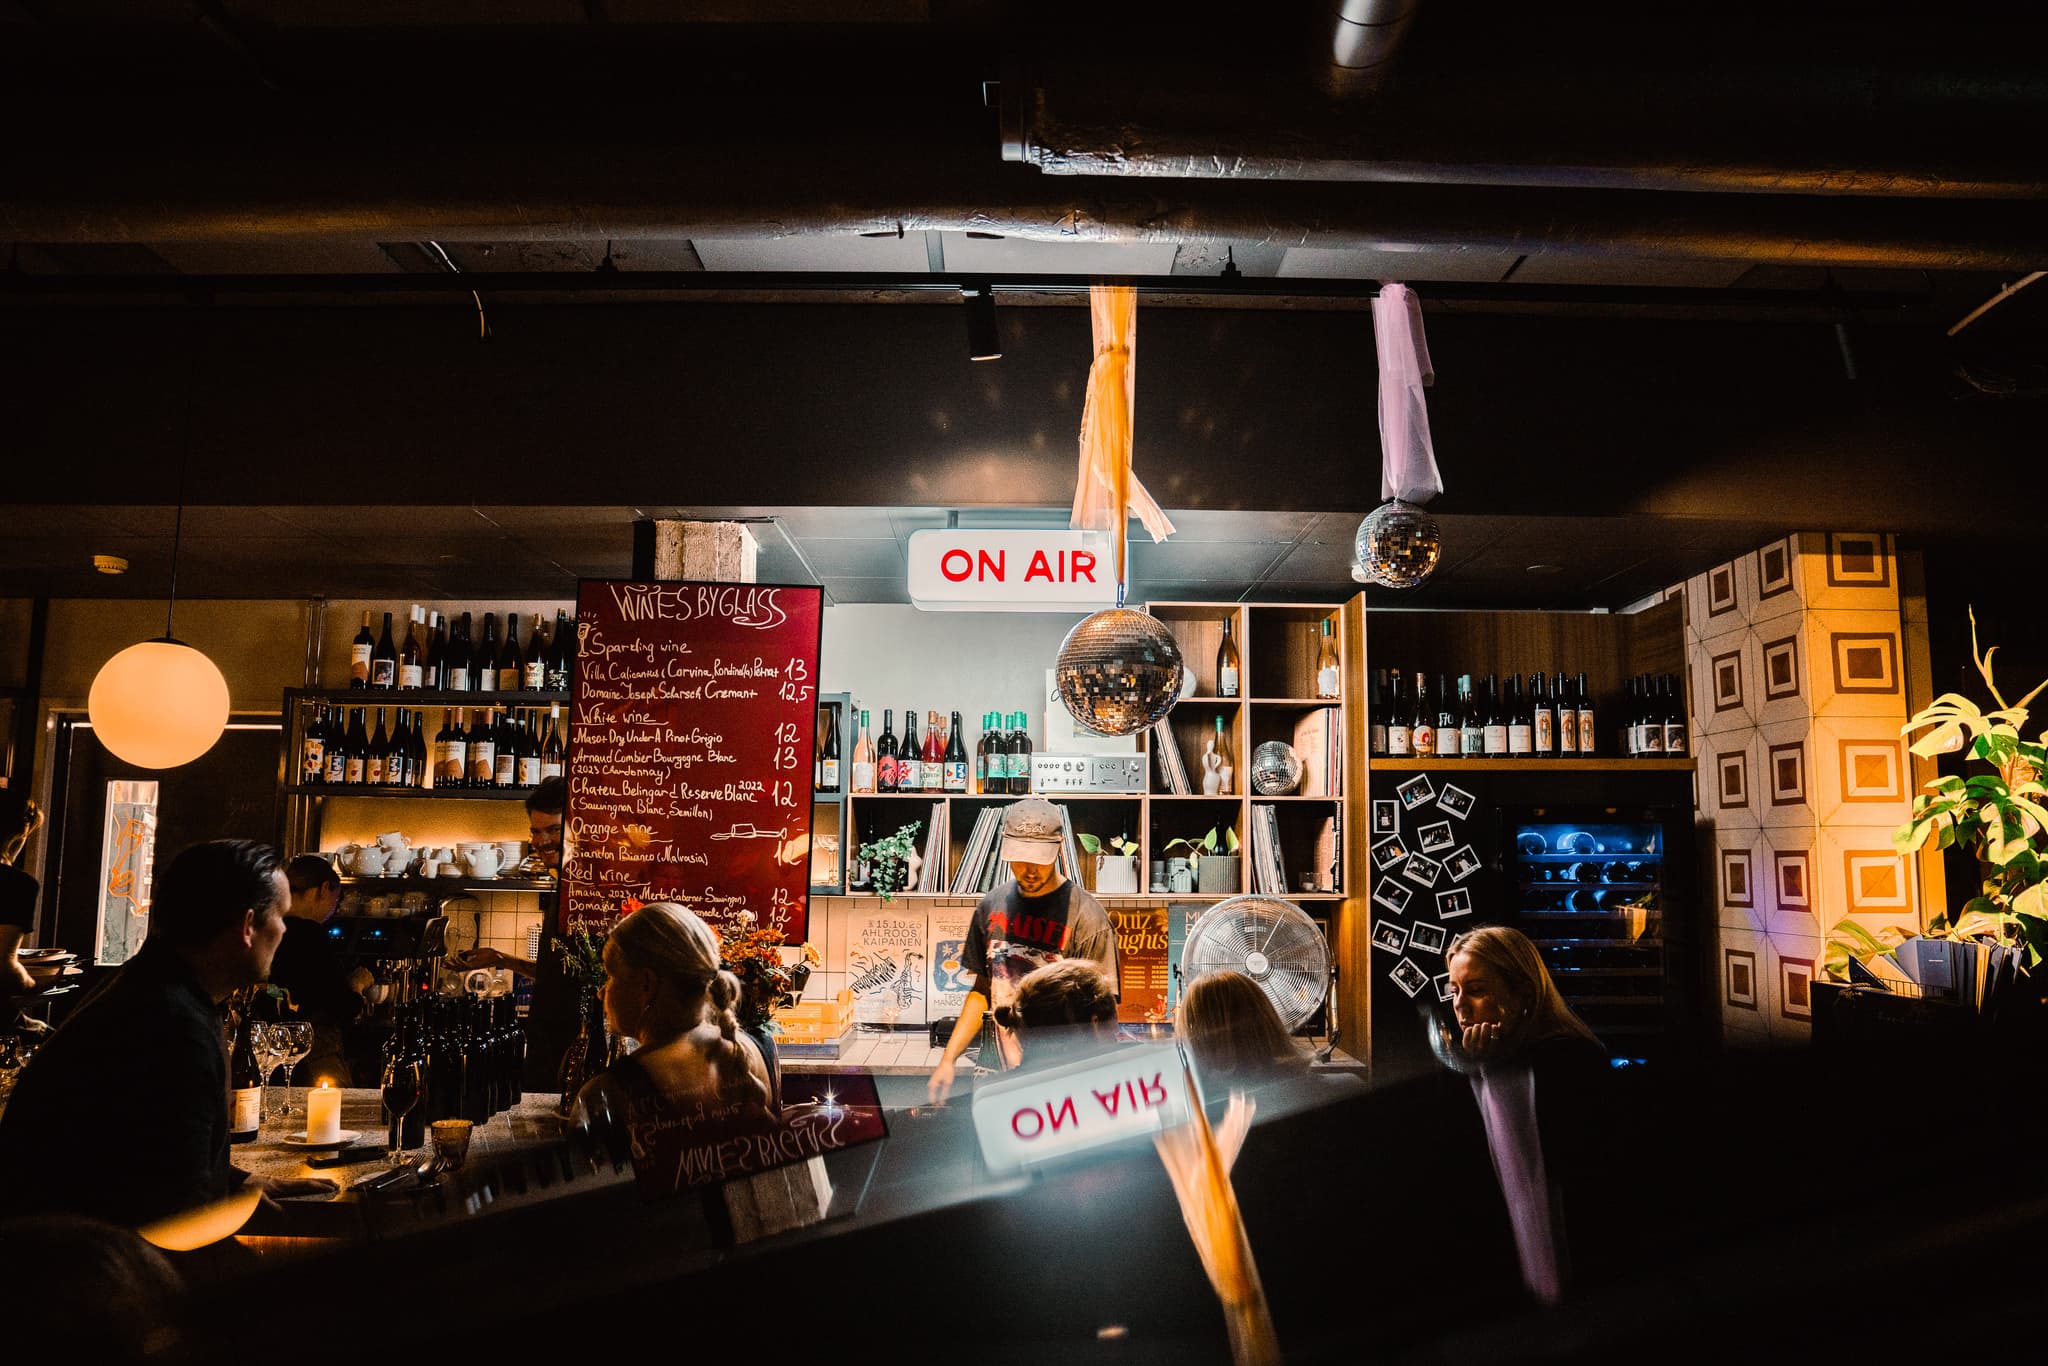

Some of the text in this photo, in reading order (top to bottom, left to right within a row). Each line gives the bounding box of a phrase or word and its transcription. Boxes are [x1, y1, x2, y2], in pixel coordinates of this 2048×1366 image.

[940, 549, 1097, 583] ON AIR
[610, 584, 692, 621] WINES
[660, 640, 693, 654] wine
[581, 660, 607, 681] Villa
[784, 657, 808, 681] 13
[581, 681, 620, 700] Domaine
[619, 681, 659, 704] Joseph
[778, 681, 815, 704] 12,5
[578, 702, 657, 724] White wine
[609, 728, 626, 747] Dry
[665, 728, 691, 743] Pinot
[691, 727, 723, 749] Grigio
[774, 723, 801, 745] 12
[573, 747, 613, 764] Arnaud
[653, 747, 704, 769] Bourgogne
[707, 749, 737, 763] Blanc
[773, 746, 798, 770] 13
[681, 782, 724, 800] Reserve
[723, 783, 758, 803] Blanc
[738, 780, 766, 793] 2022
[771, 780, 798, 808] 12
[571, 817, 659, 843] Orange wine
[565, 860, 637, 882] Red wine
[771, 887, 794, 906] 12
[769, 906, 792, 923] 12
[1108, 910, 1151, 929] Quiz
[862, 936, 922, 947] KAIPAINEN
